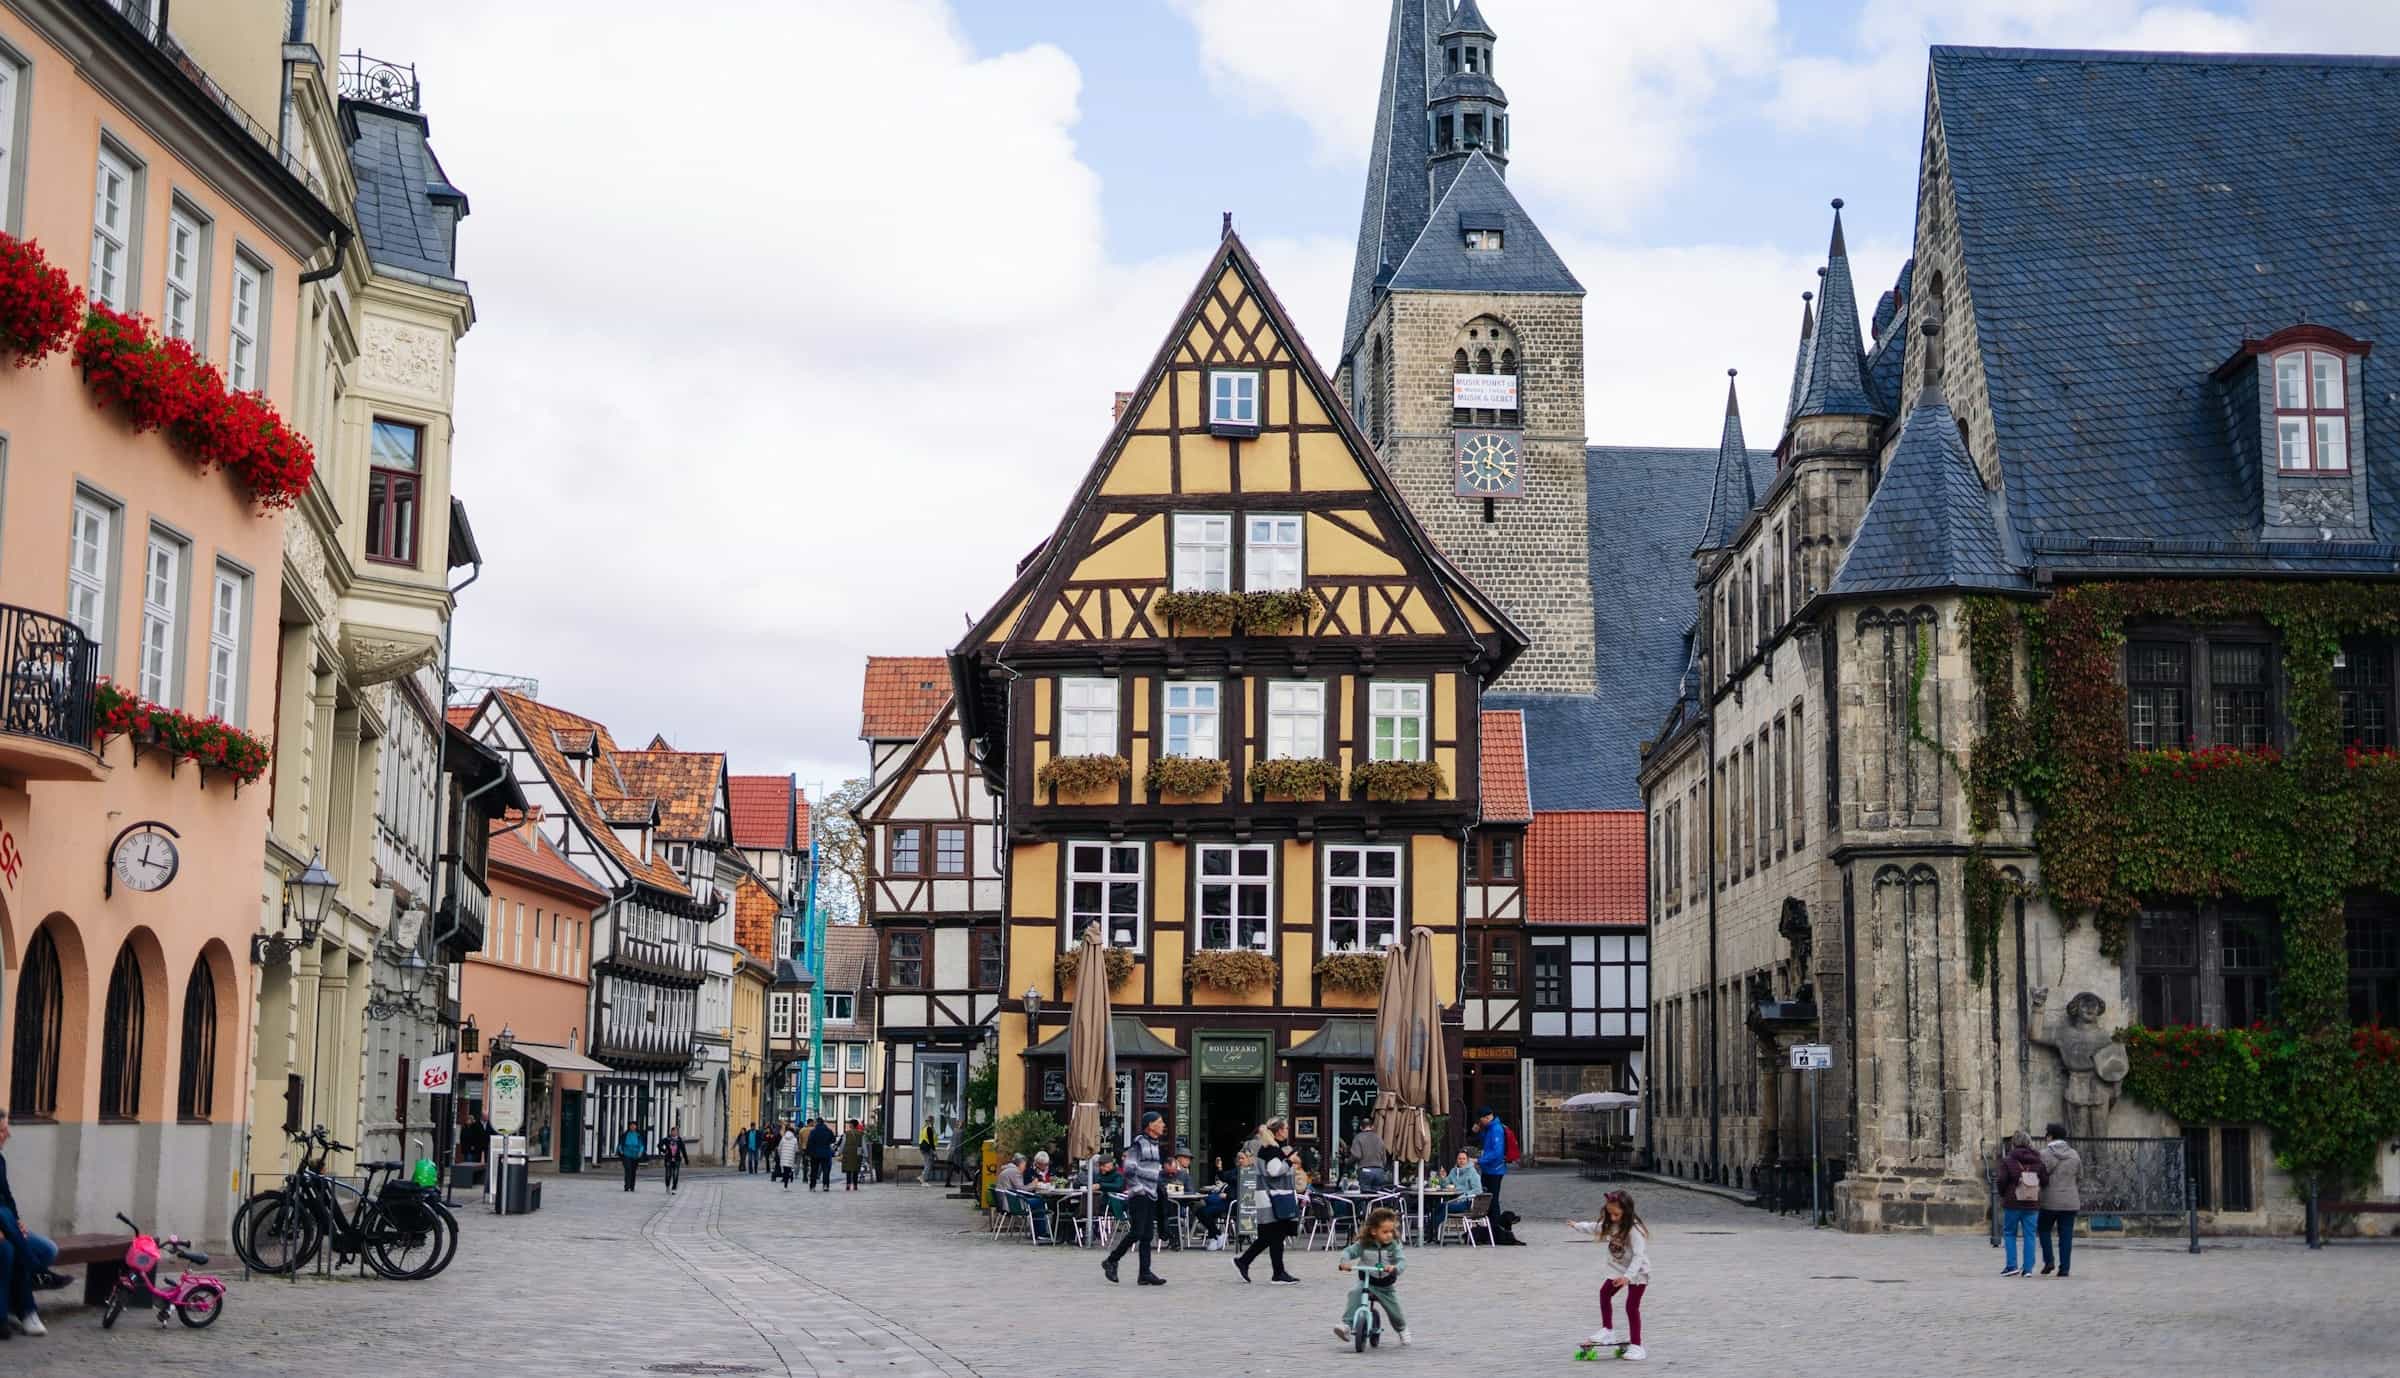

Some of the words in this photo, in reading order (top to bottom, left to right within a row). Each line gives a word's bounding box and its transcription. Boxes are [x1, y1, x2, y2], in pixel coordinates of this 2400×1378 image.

[1456, 378, 1481, 386] MUSIK
[1457, 393, 1481, 401] MUSIK
[0, 819, 22, 891] SE
[423, 1067, 448, 1088] Eis
[1335, 1076, 1378, 1086] BOULEVA
[1336, 1089, 1377, 1106] CAF
